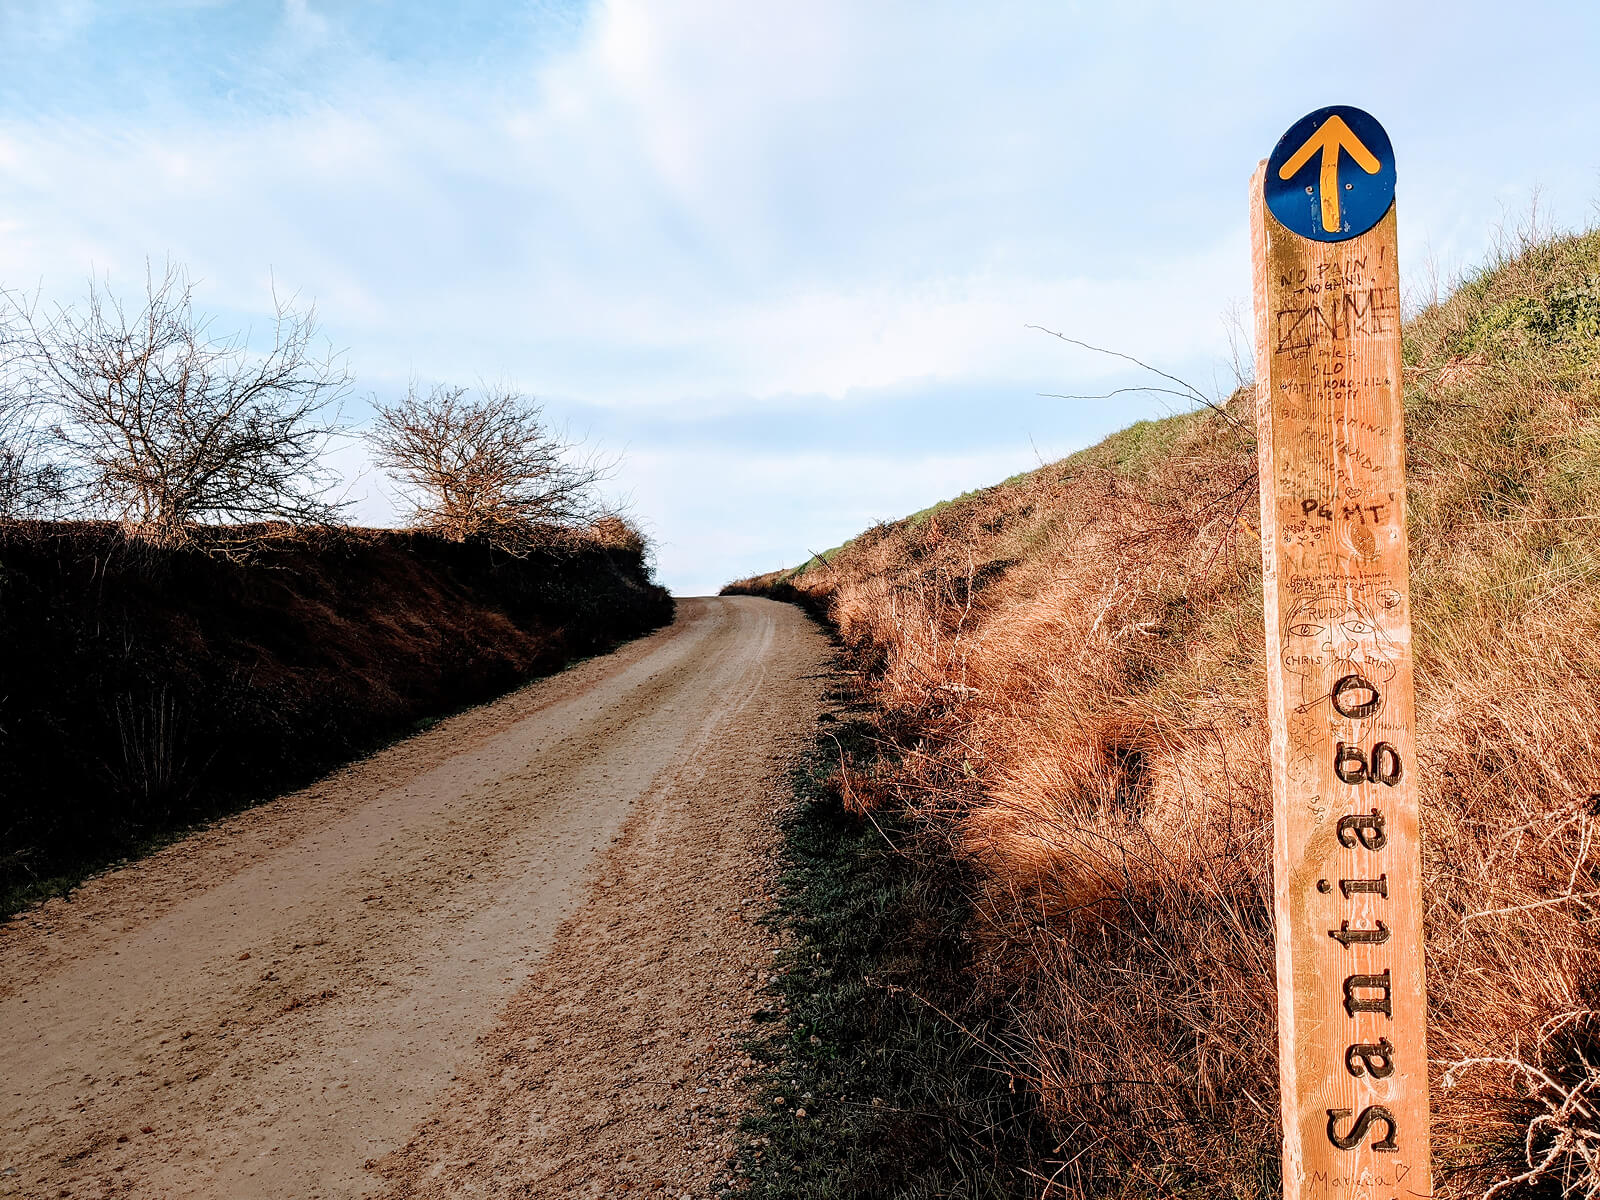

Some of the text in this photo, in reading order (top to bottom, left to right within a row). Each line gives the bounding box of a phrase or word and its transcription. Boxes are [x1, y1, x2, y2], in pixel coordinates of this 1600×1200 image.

[1280, 269, 1307, 287] NO
[1317, 256, 1367, 279] PAIN
[1307, 606, 1351, 621] RUDY
[1285, 656, 1323, 666] CHRIS
[1315, 674, 1403, 1153] Santiago
